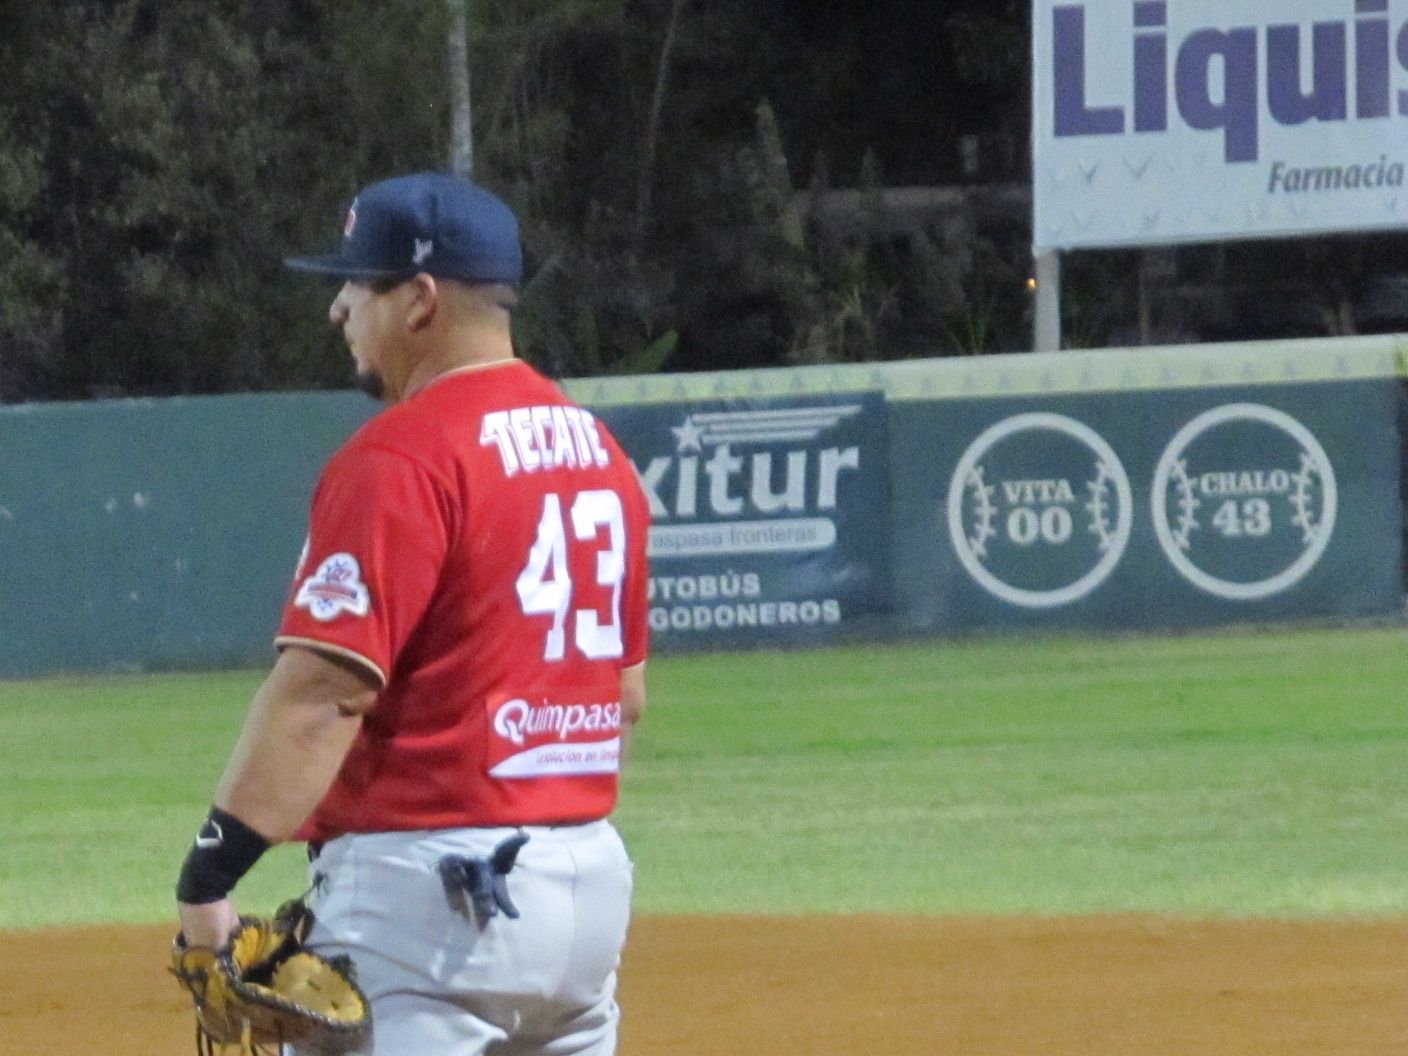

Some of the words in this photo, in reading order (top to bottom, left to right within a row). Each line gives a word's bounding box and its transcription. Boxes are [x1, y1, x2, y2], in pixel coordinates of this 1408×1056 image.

[1268, 156, 1405, 194] Farmacia
[480, 405, 610, 477] TECATE
[1002, 478, 1075, 503] VITA
[1201, 469, 1290, 496] CHALO
[1006, 507, 1074, 545] 00
[1212, 499, 1272, 537] 43
[516, 489, 627, 661] 43
